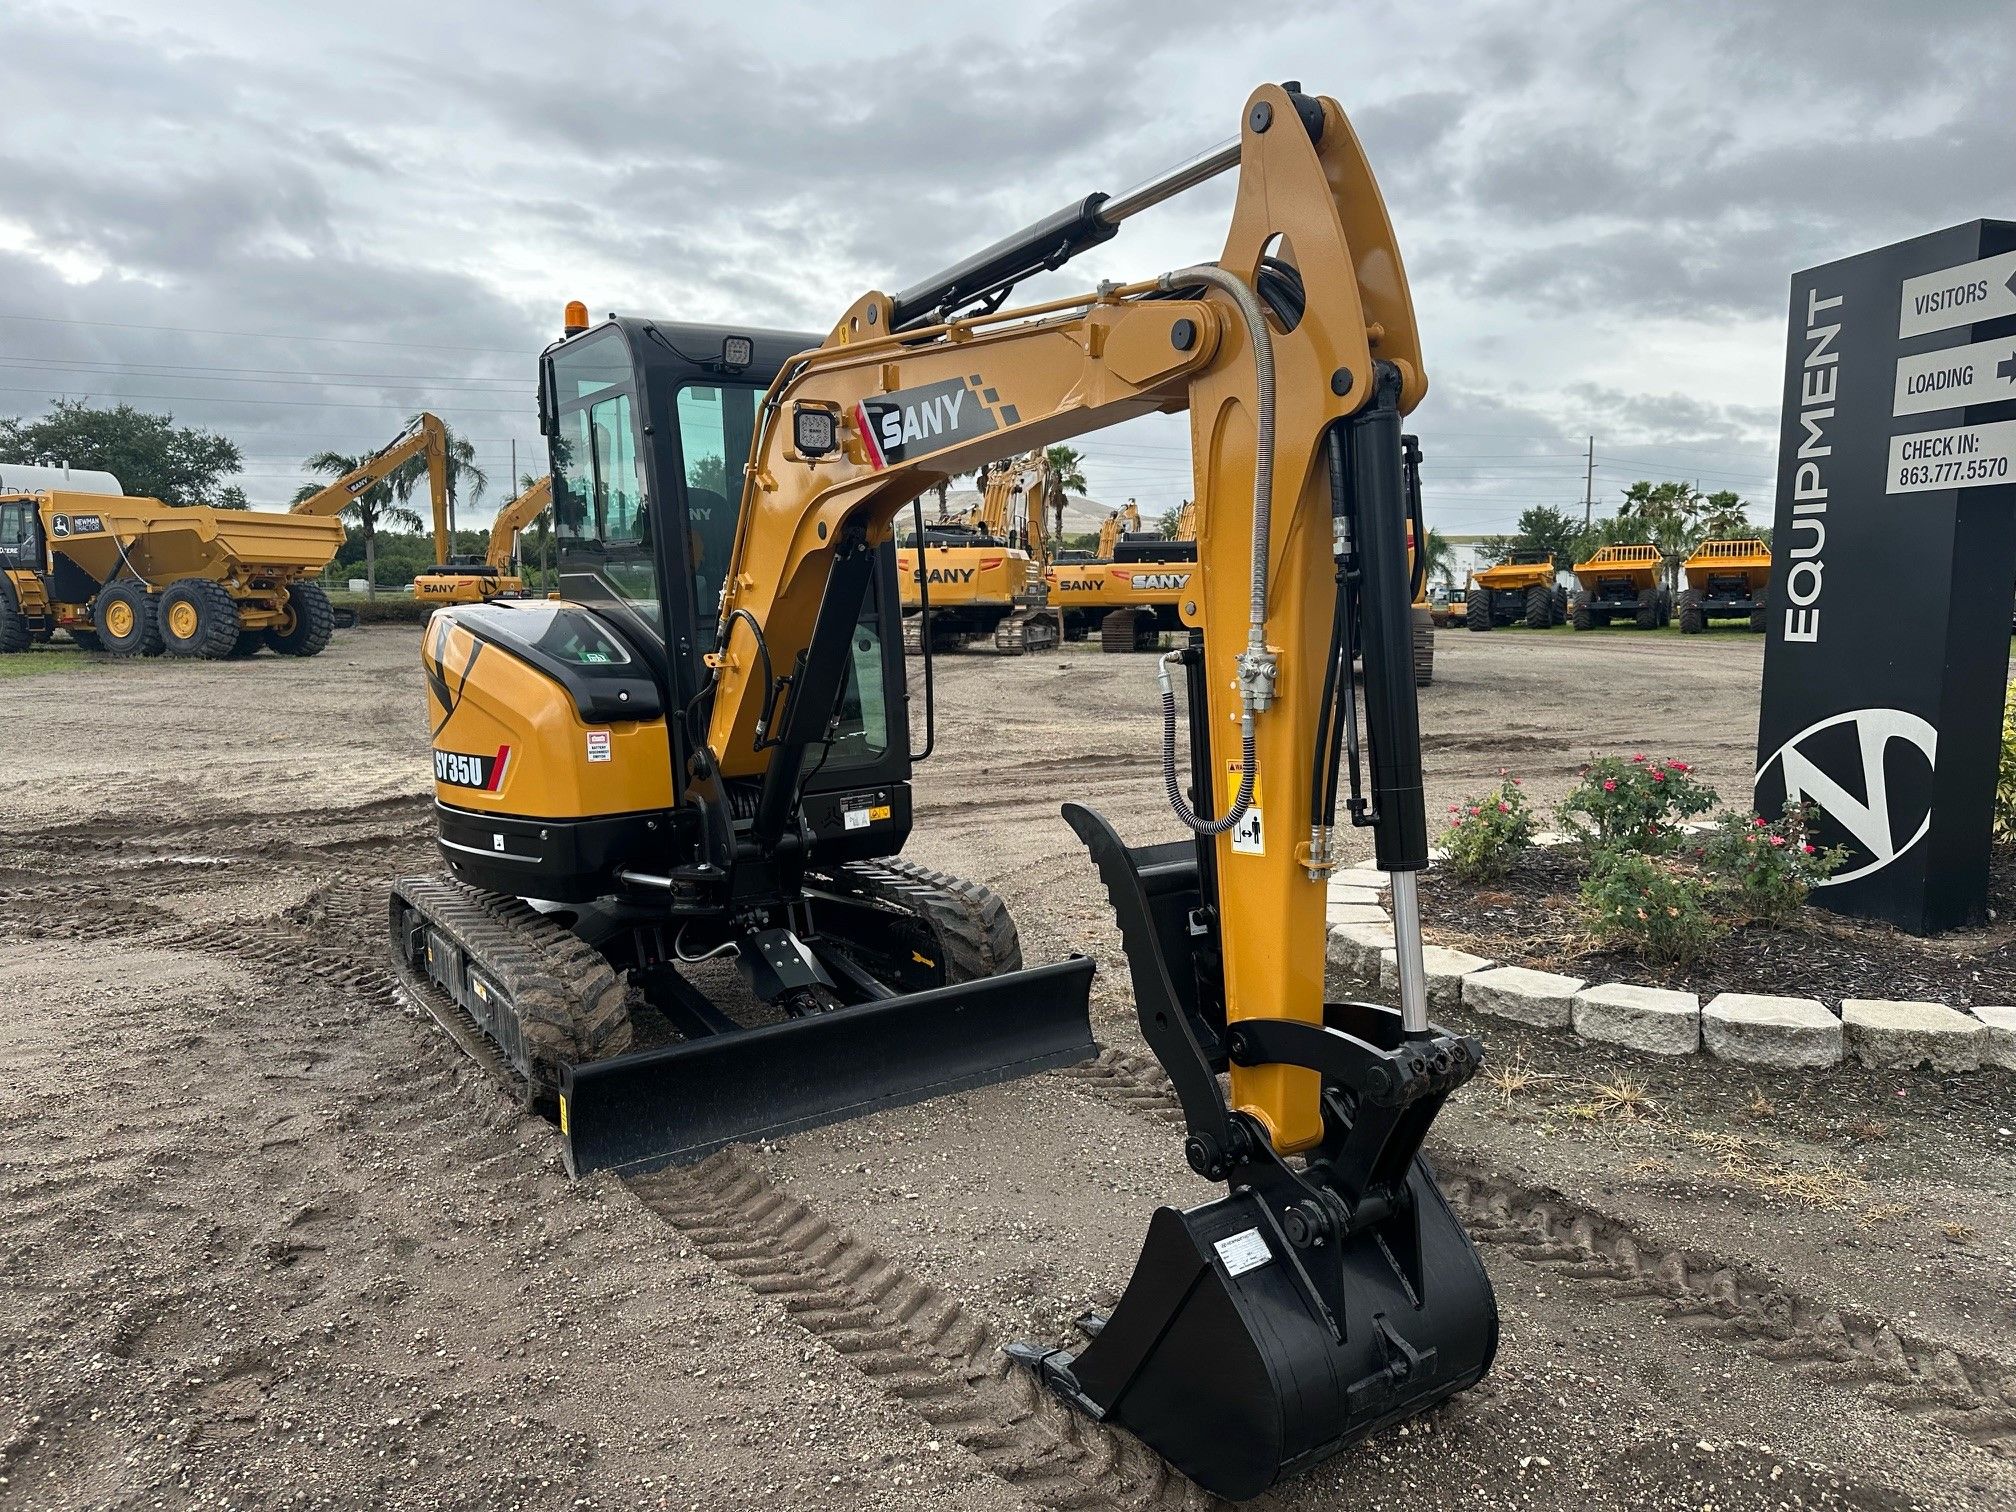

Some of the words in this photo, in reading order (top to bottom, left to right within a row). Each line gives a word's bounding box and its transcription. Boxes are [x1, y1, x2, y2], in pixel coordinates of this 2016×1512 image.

[1914, 280, 1988, 315] VISITORS
[1907, 365, 1974, 395] LOADING
[881, 388, 965, 450] SANY
[1902, 435, 1954, 461] CHECK
[1957, 433, 1979, 455] IN:
[1784, 288, 1843, 643] EQUIPMENT
[1899, 456, 2008, 486] 863.777.5570
[350, 477, 368, 492] SANY
[74, 517, 100, 526] NEWMAN
[689, 508, 712, 520] NY
[423, 584, 456, 593] SANY
[1060, 580, 1105, 591] SANY
[1131, 573, 1192, 590] SANY
[435, 750, 483, 786] SY35U
